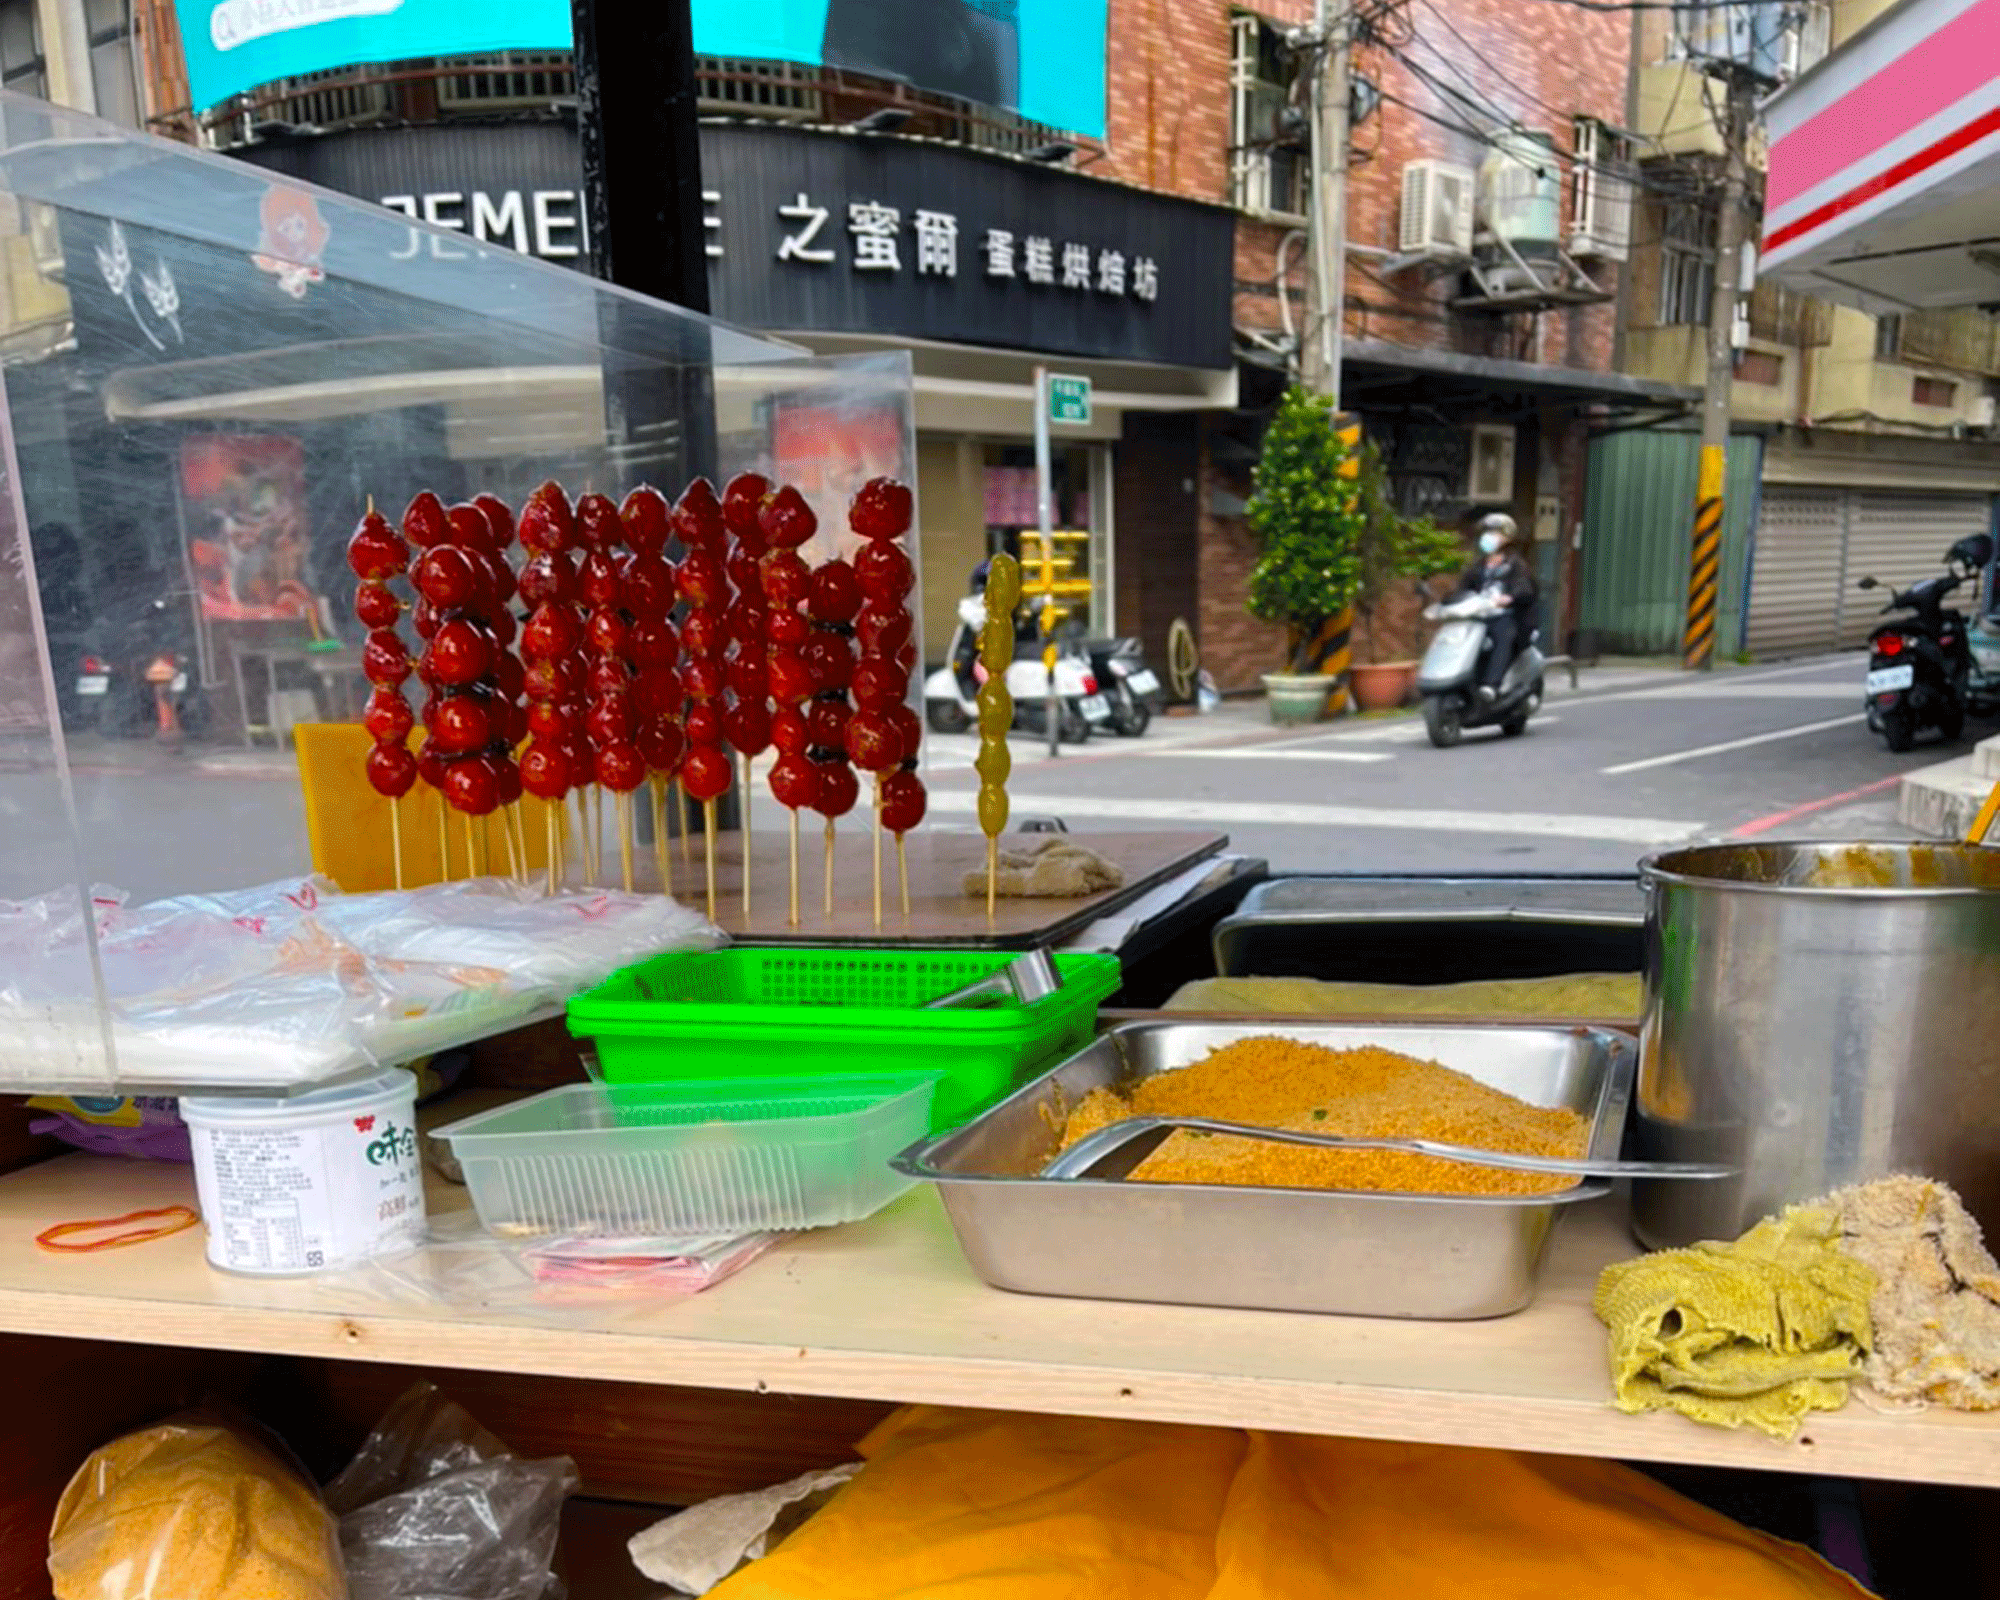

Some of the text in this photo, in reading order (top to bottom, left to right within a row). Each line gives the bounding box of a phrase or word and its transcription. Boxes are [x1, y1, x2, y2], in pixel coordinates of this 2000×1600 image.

[777, 193, 959, 278] 之蜜爾
[985, 228, 1159, 301] 蛋糕烘焙坊
